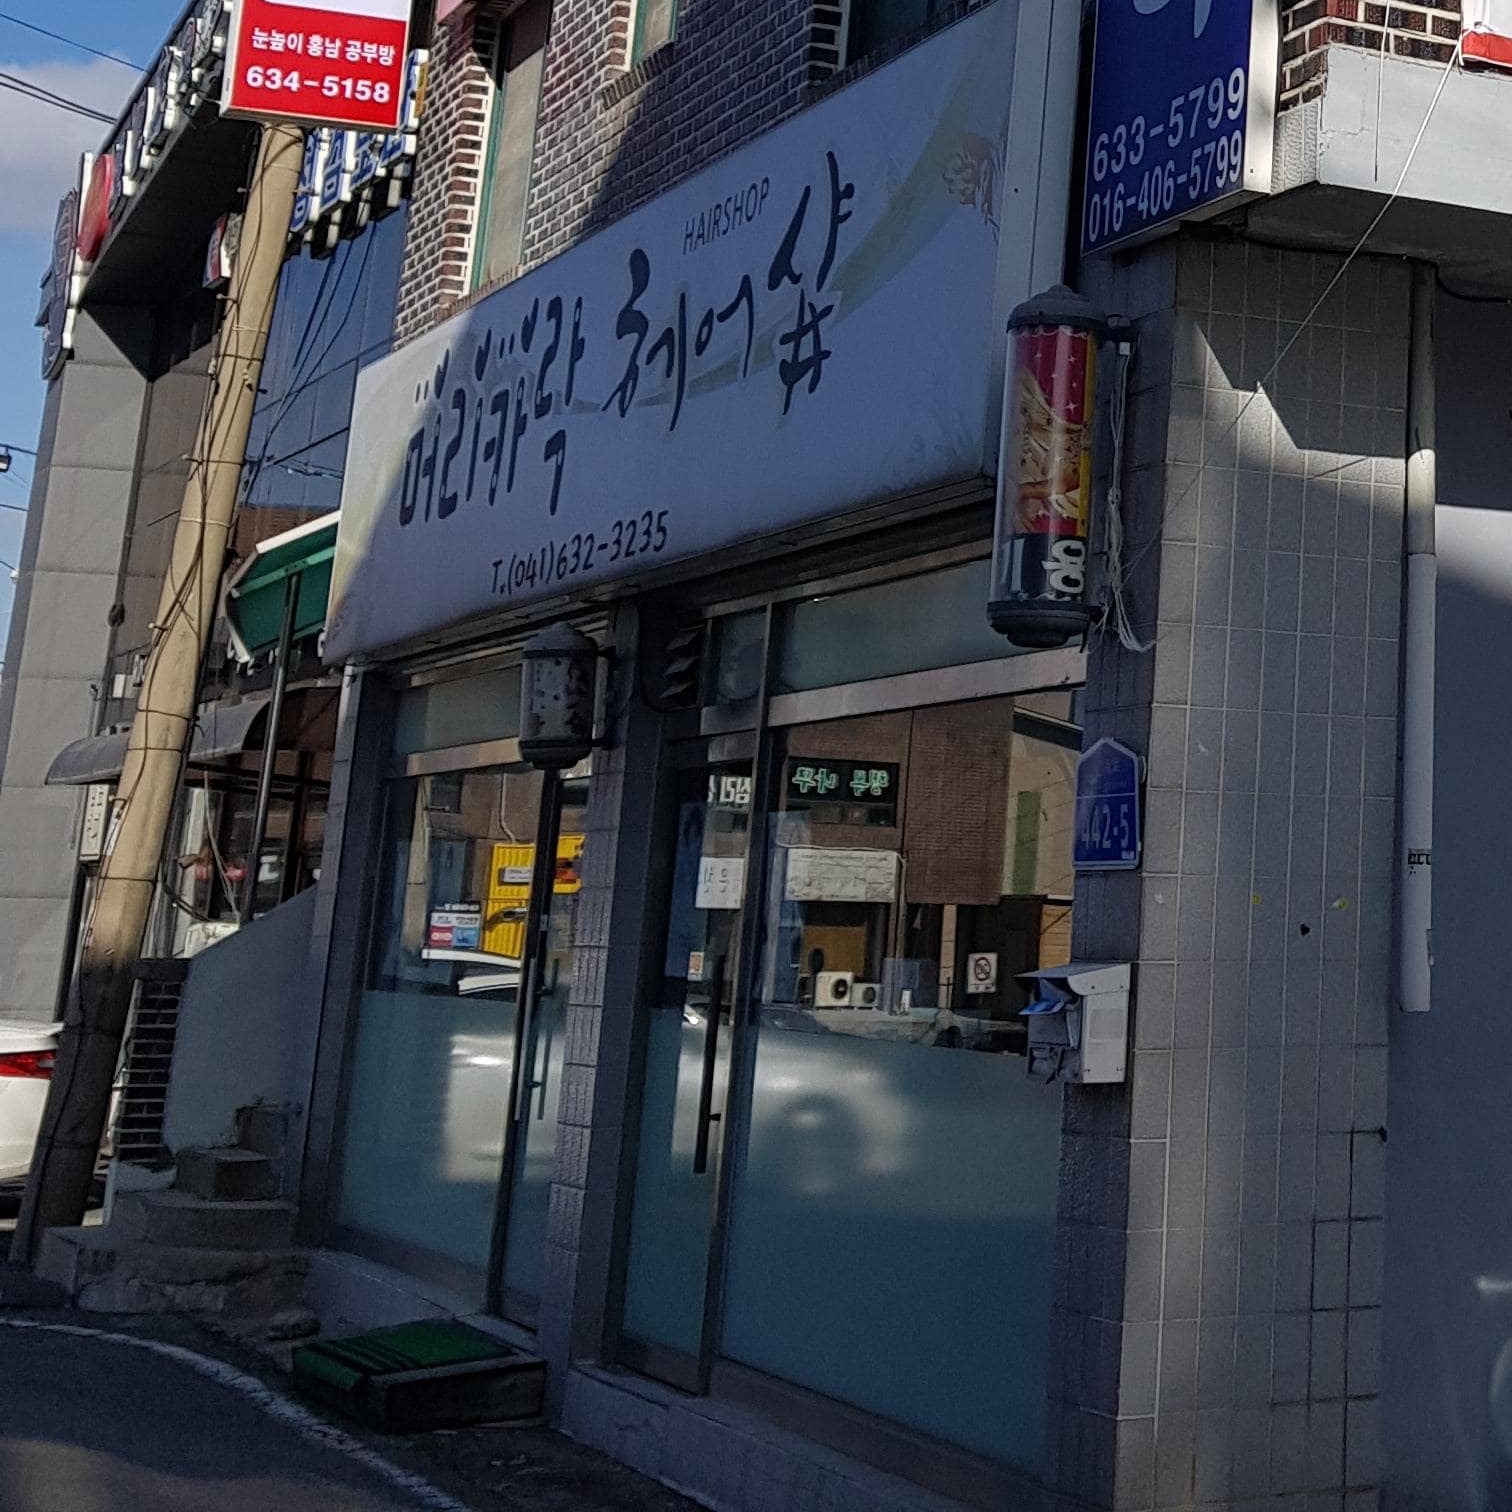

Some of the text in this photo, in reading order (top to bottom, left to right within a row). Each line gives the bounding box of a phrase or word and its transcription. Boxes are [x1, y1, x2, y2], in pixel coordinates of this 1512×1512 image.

[246, 65, 390, 104] 634-5158
[251, 26, 396, 67] 눈높이 홍남 공부방
[1094, 67, 1246, 180] 633-5799
[683, 177, 770, 255] HAIRSHOP
[1088, 128, 1243, 243] 016-406-5799
